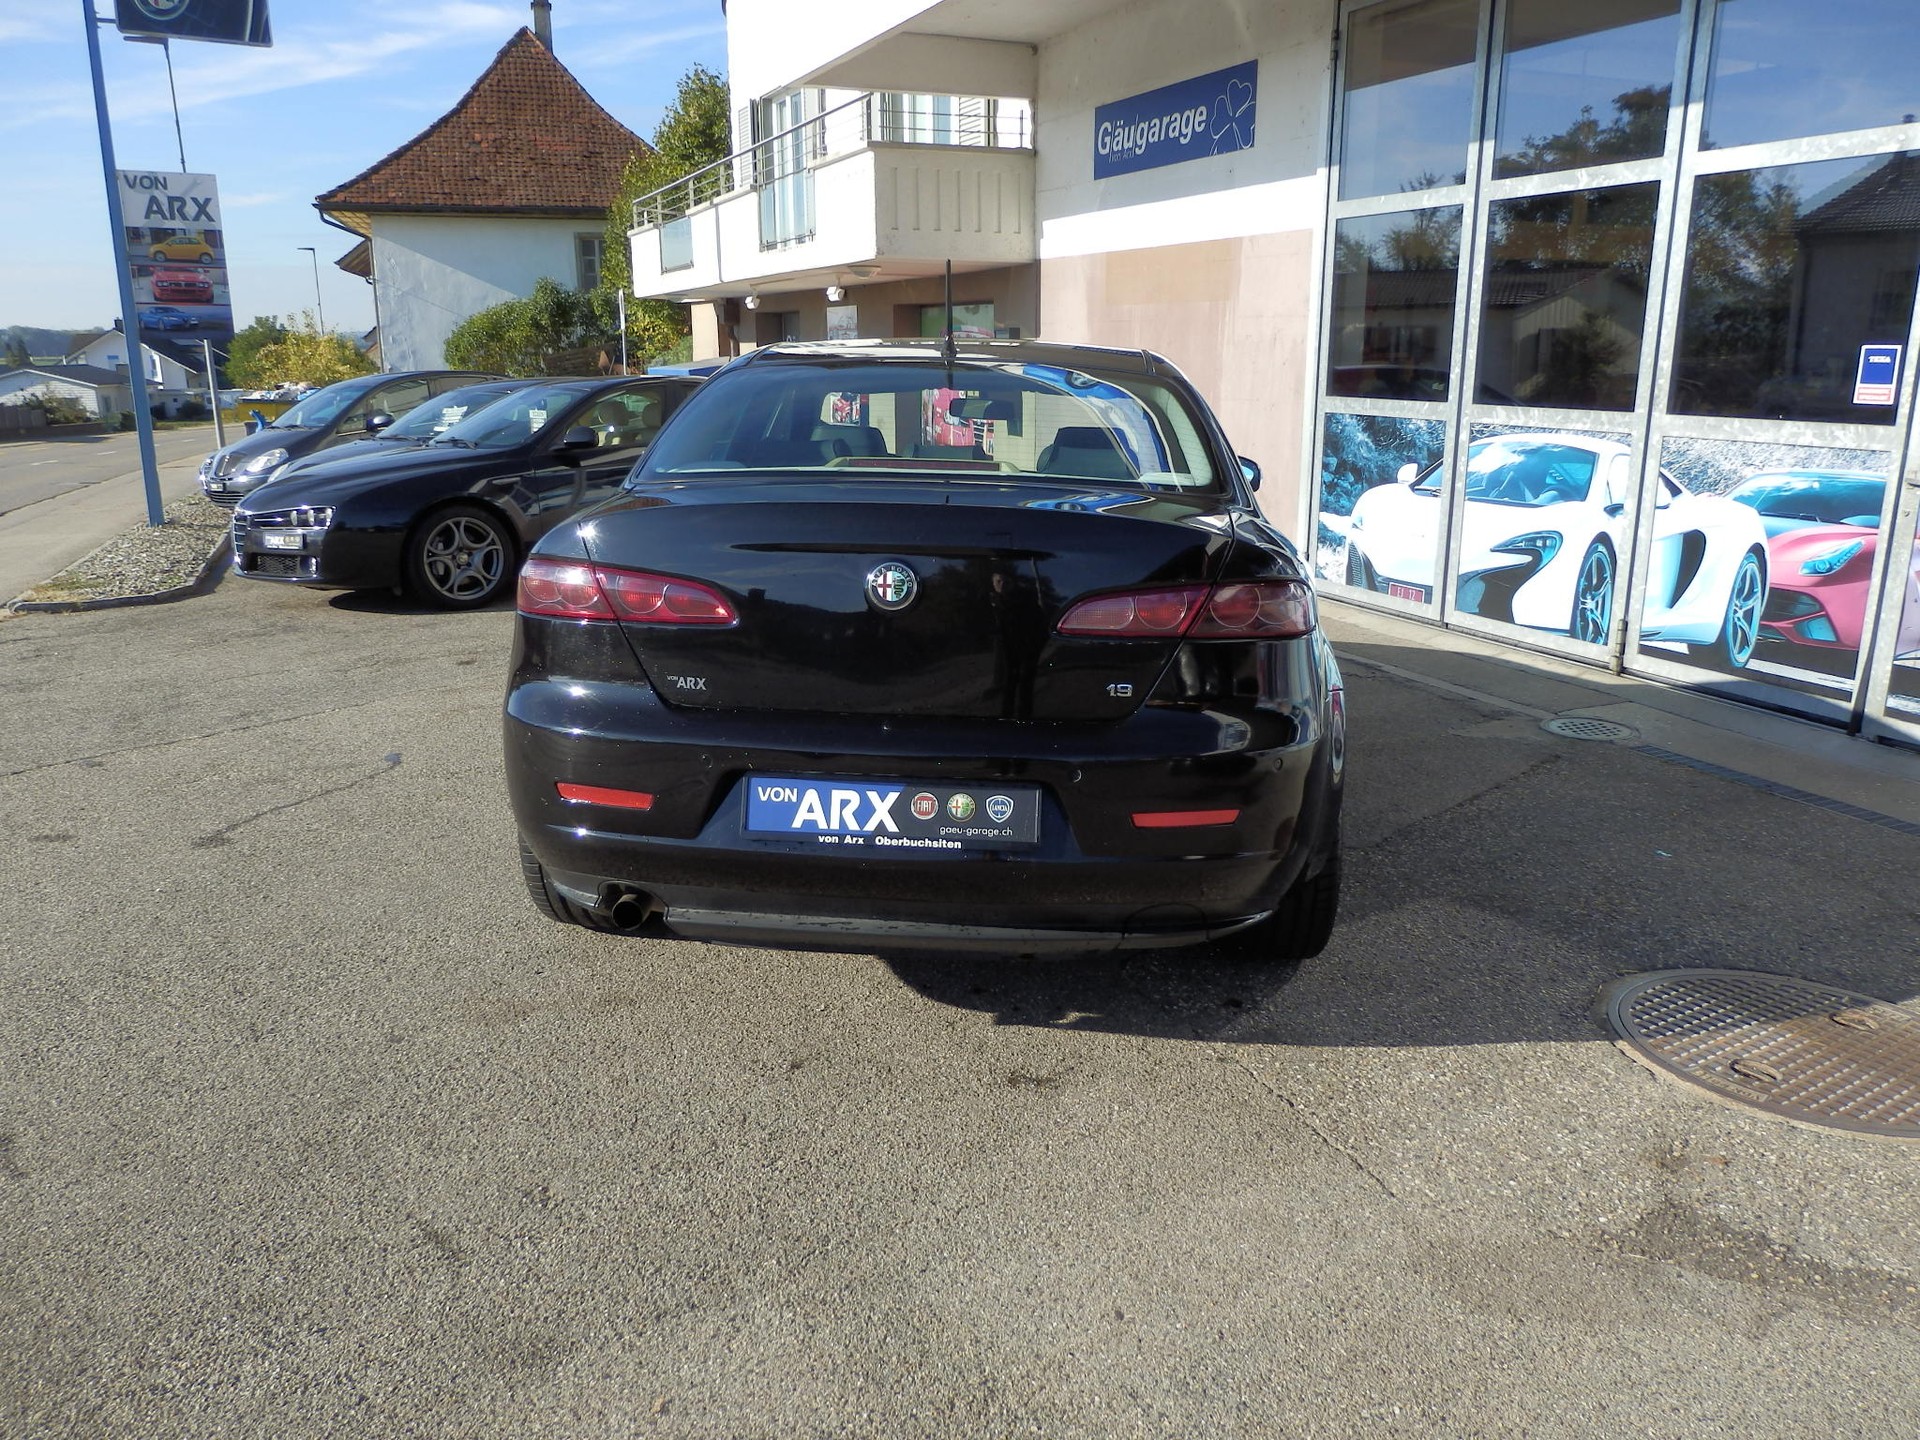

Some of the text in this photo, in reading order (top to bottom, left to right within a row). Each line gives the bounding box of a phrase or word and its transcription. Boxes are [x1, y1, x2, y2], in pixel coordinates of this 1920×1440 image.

[1098, 105, 1207, 155] Gäugarage
[123, 174, 168, 190] VON
[144, 195, 216, 222] ARX
[677, 676, 707, 690] ARX
[758, 786, 901, 832] VON ARX
[916, 800, 934, 813] FIAT
[991, 804, 1008, 812] LANCIA
[939, 826, 1013, 838] gaeu-garage.ch
[818, 834, 962, 849] von Arx Oberbuchsiten
